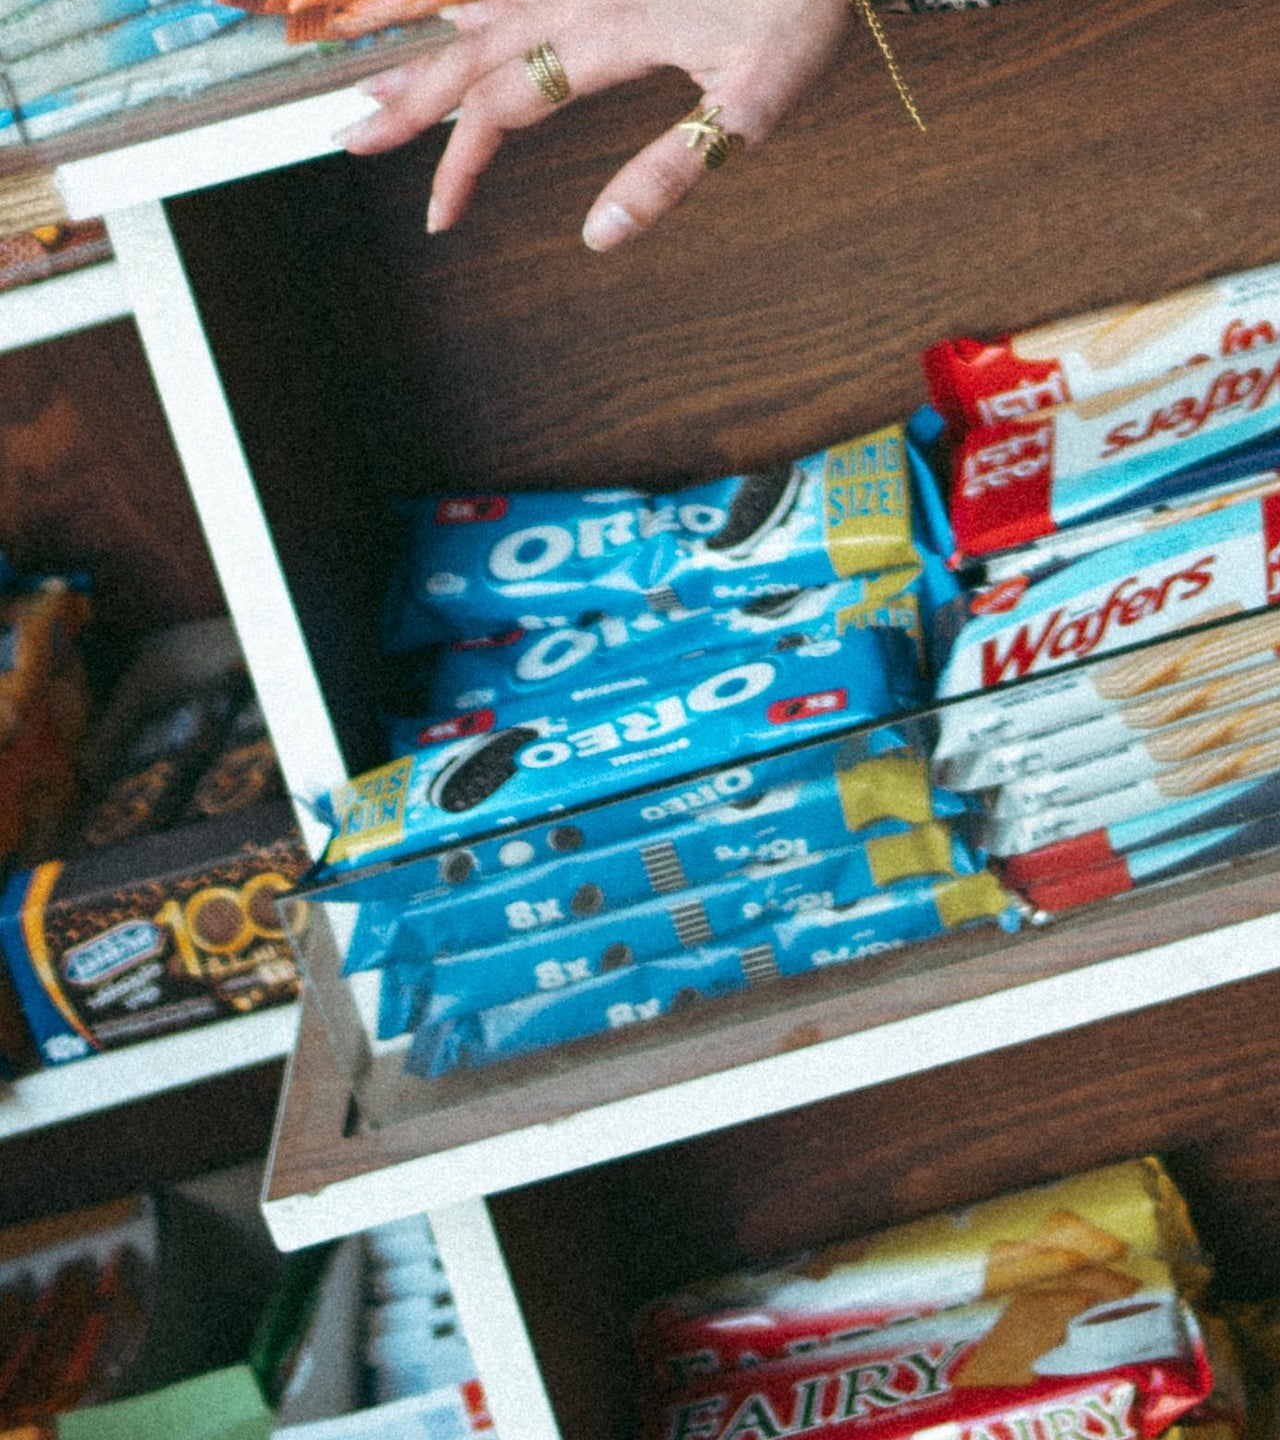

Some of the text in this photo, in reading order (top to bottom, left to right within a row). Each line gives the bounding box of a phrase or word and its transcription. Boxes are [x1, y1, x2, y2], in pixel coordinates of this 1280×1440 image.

[825, 475, 903, 526] SIZE!
[489, 505, 726, 580] OREO
[981, 555, 1216, 686] Wafers
[522, 662, 775, 769] OREO
[506, 888, 560, 928] 8x
[536, 948, 593, 987] 8x
[607, 992, 662, 1028] 8x
[671, 1341, 964, 1440] FAIRY
